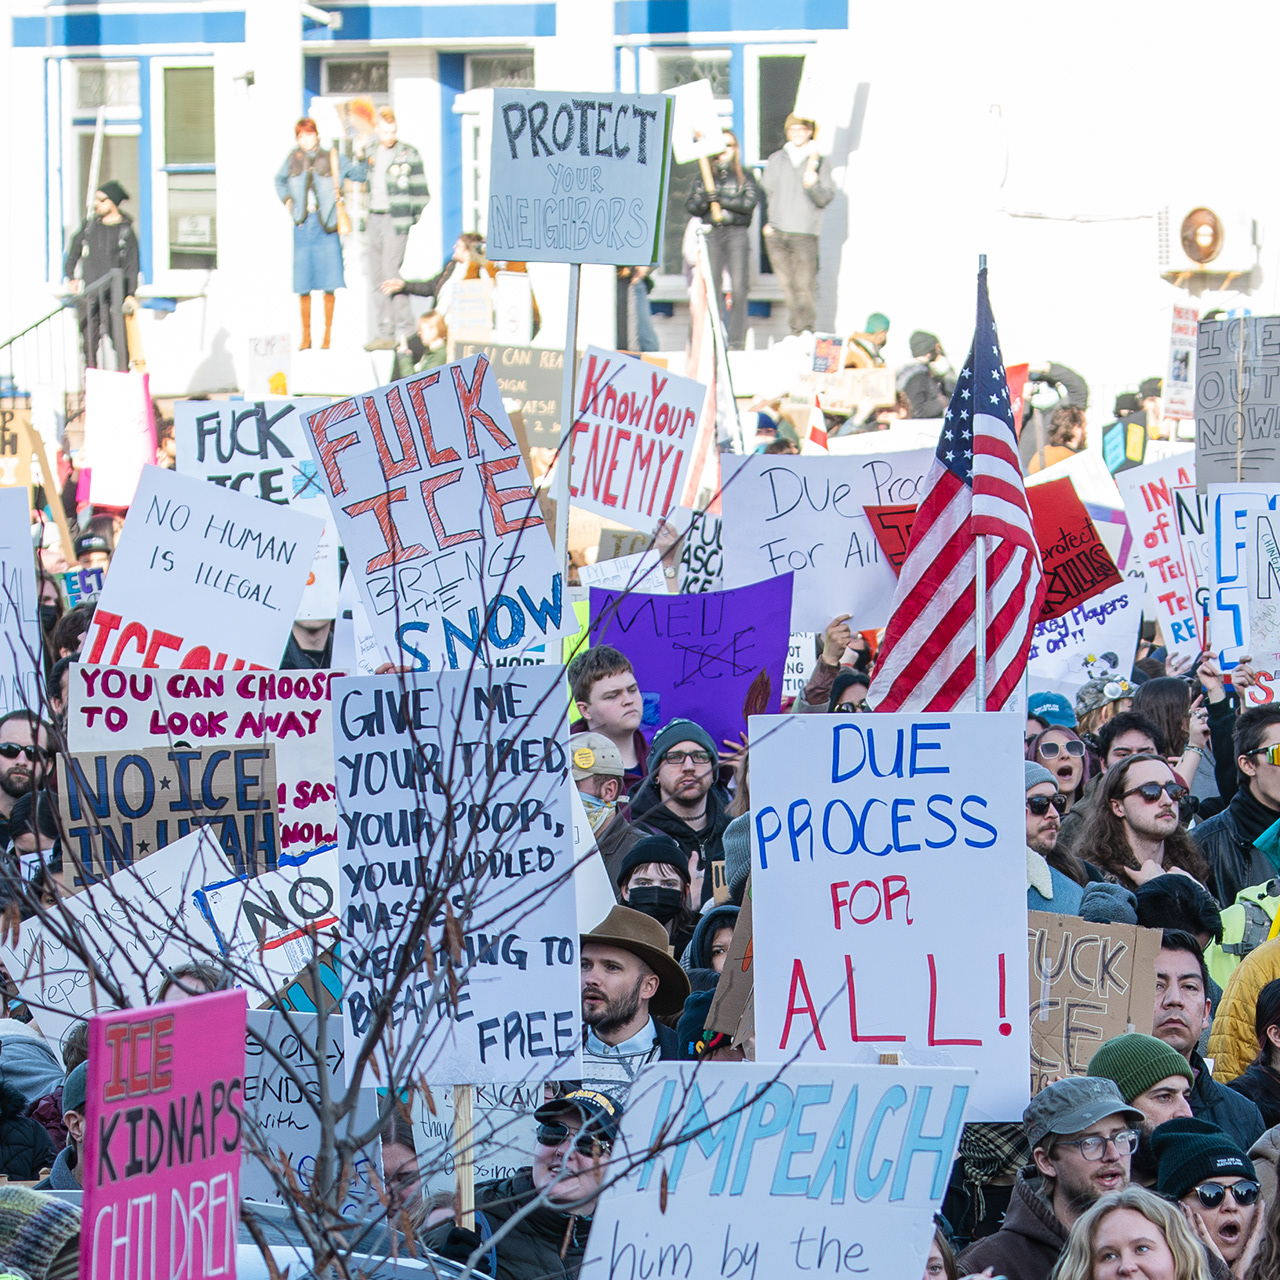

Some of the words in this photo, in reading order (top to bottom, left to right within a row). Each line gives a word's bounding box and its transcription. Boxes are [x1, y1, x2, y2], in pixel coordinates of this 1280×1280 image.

[502, 98, 657, 164] PROTECT
[547, 163, 603, 195] YOUR
[491, 195, 649, 251] NEIGHBORS
[1197, 366, 1280, 411] OUT
[196, 402, 295, 462] FUCK
[307, 357, 517, 497] FUCK
[146, 494, 191, 532] NO
[204, 514, 297, 564] HUMAN
[342, 455, 544, 574] ICE
[150, 546, 174, 572] IS
[366, 543, 525, 616] BRING
[759, 541, 825, 576] For
[397, 573, 562, 672] SNOW
[410, 578, 463, 618] THE
[590, 592, 735, 638] MELT
[80, 669, 153, 701] YOU
[167, 674, 227, 701] CAN
[236, 671, 333, 701] CHOOSE
[341, 687, 437, 742] GIVE
[474, 684, 538, 723] ME
[80, 706, 128, 732] TO
[149, 710, 227, 737] LOOK
[236, 709, 321, 738] AWAY
[832, 723, 951, 784] DUE
[68, 750, 154, 819] NO
[167, 749, 271, 811] ICE
[756, 795, 999, 869] PROCESS
[244, 876, 334, 940] NO
[830, 875, 913, 930] FOR
[540, 938, 575, 964] TO
[780, 954, 1012, 1050] ALL!
[103, 1014, 174, 1102] ICE
[477, 1012, 574, 1062] FREE
[97, 1077, 242, 1187] KIDNAPS
[638, 1080, 968, 1204] IMPEACH
[791, 1227, 870, 1273] the
